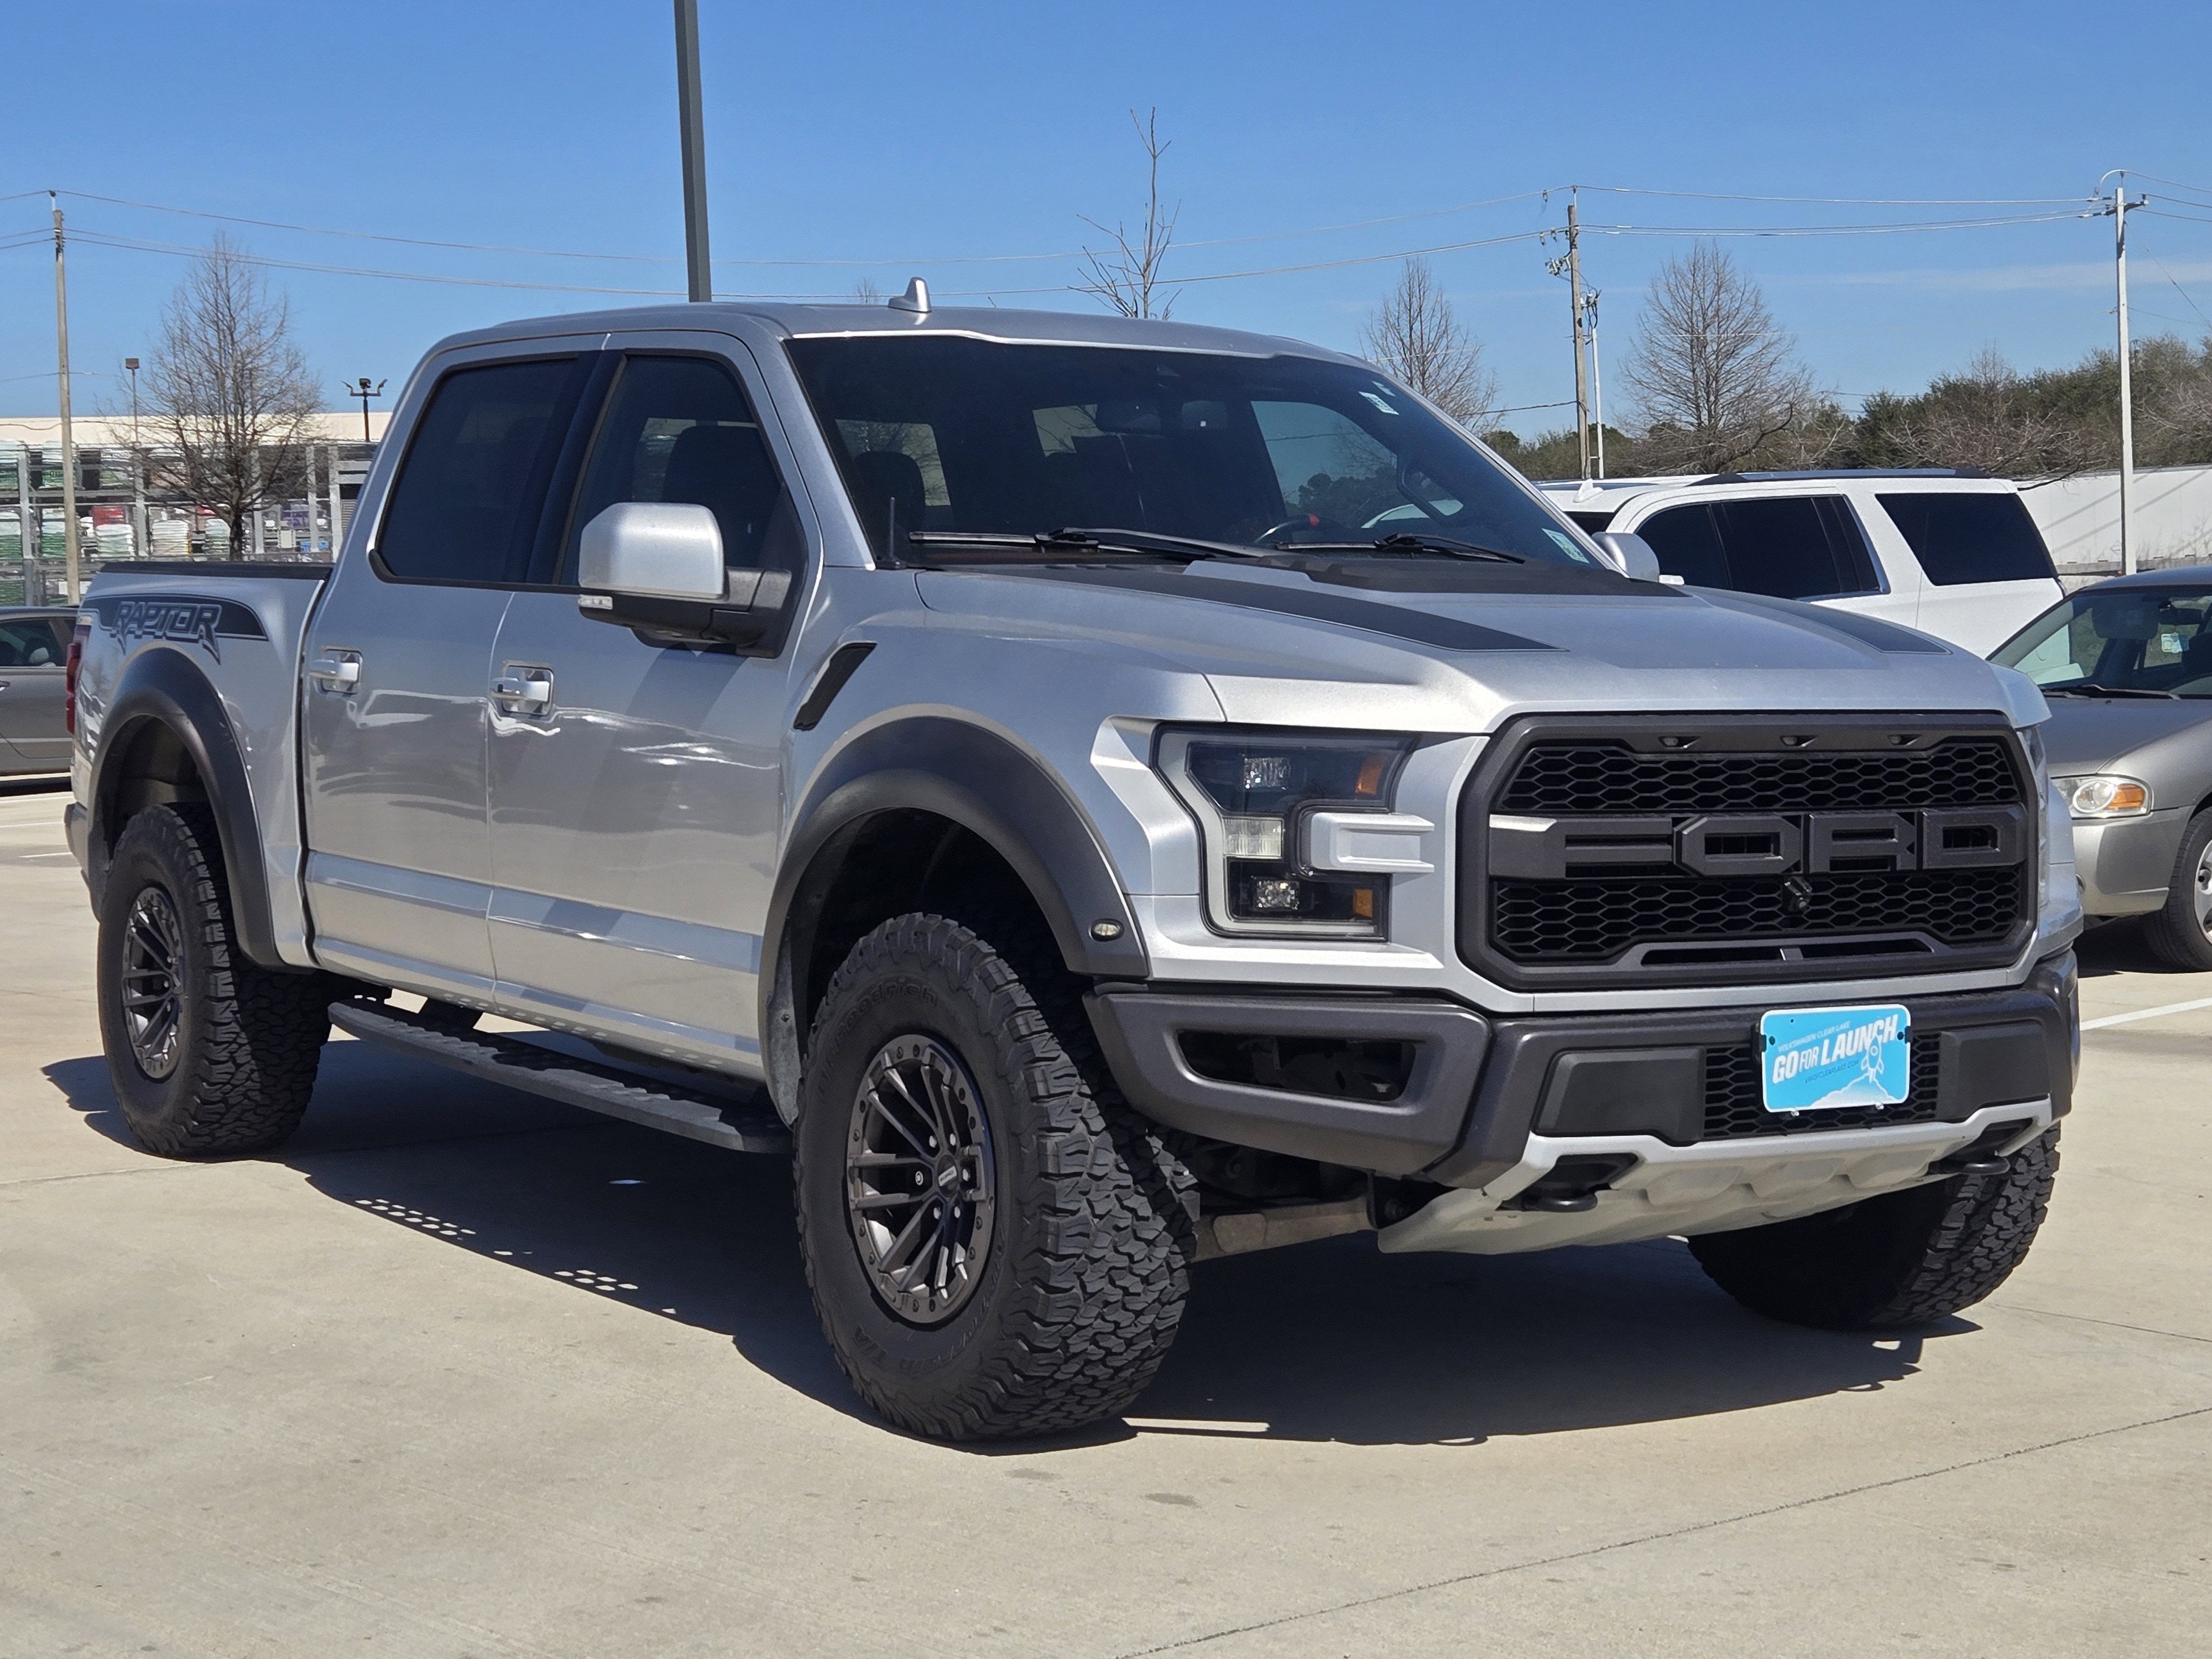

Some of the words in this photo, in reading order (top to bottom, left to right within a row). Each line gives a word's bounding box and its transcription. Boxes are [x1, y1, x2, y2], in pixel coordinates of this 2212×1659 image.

[112, 601, 221, 665] RAPTOR
[1490, 804, 2027, 879] FORD
[1772, 1051, 1798, 1084] GO
[1799, 1046, 1819, 1073] FOR
[1820, 1014, 1898, 1066] LAUNCH
